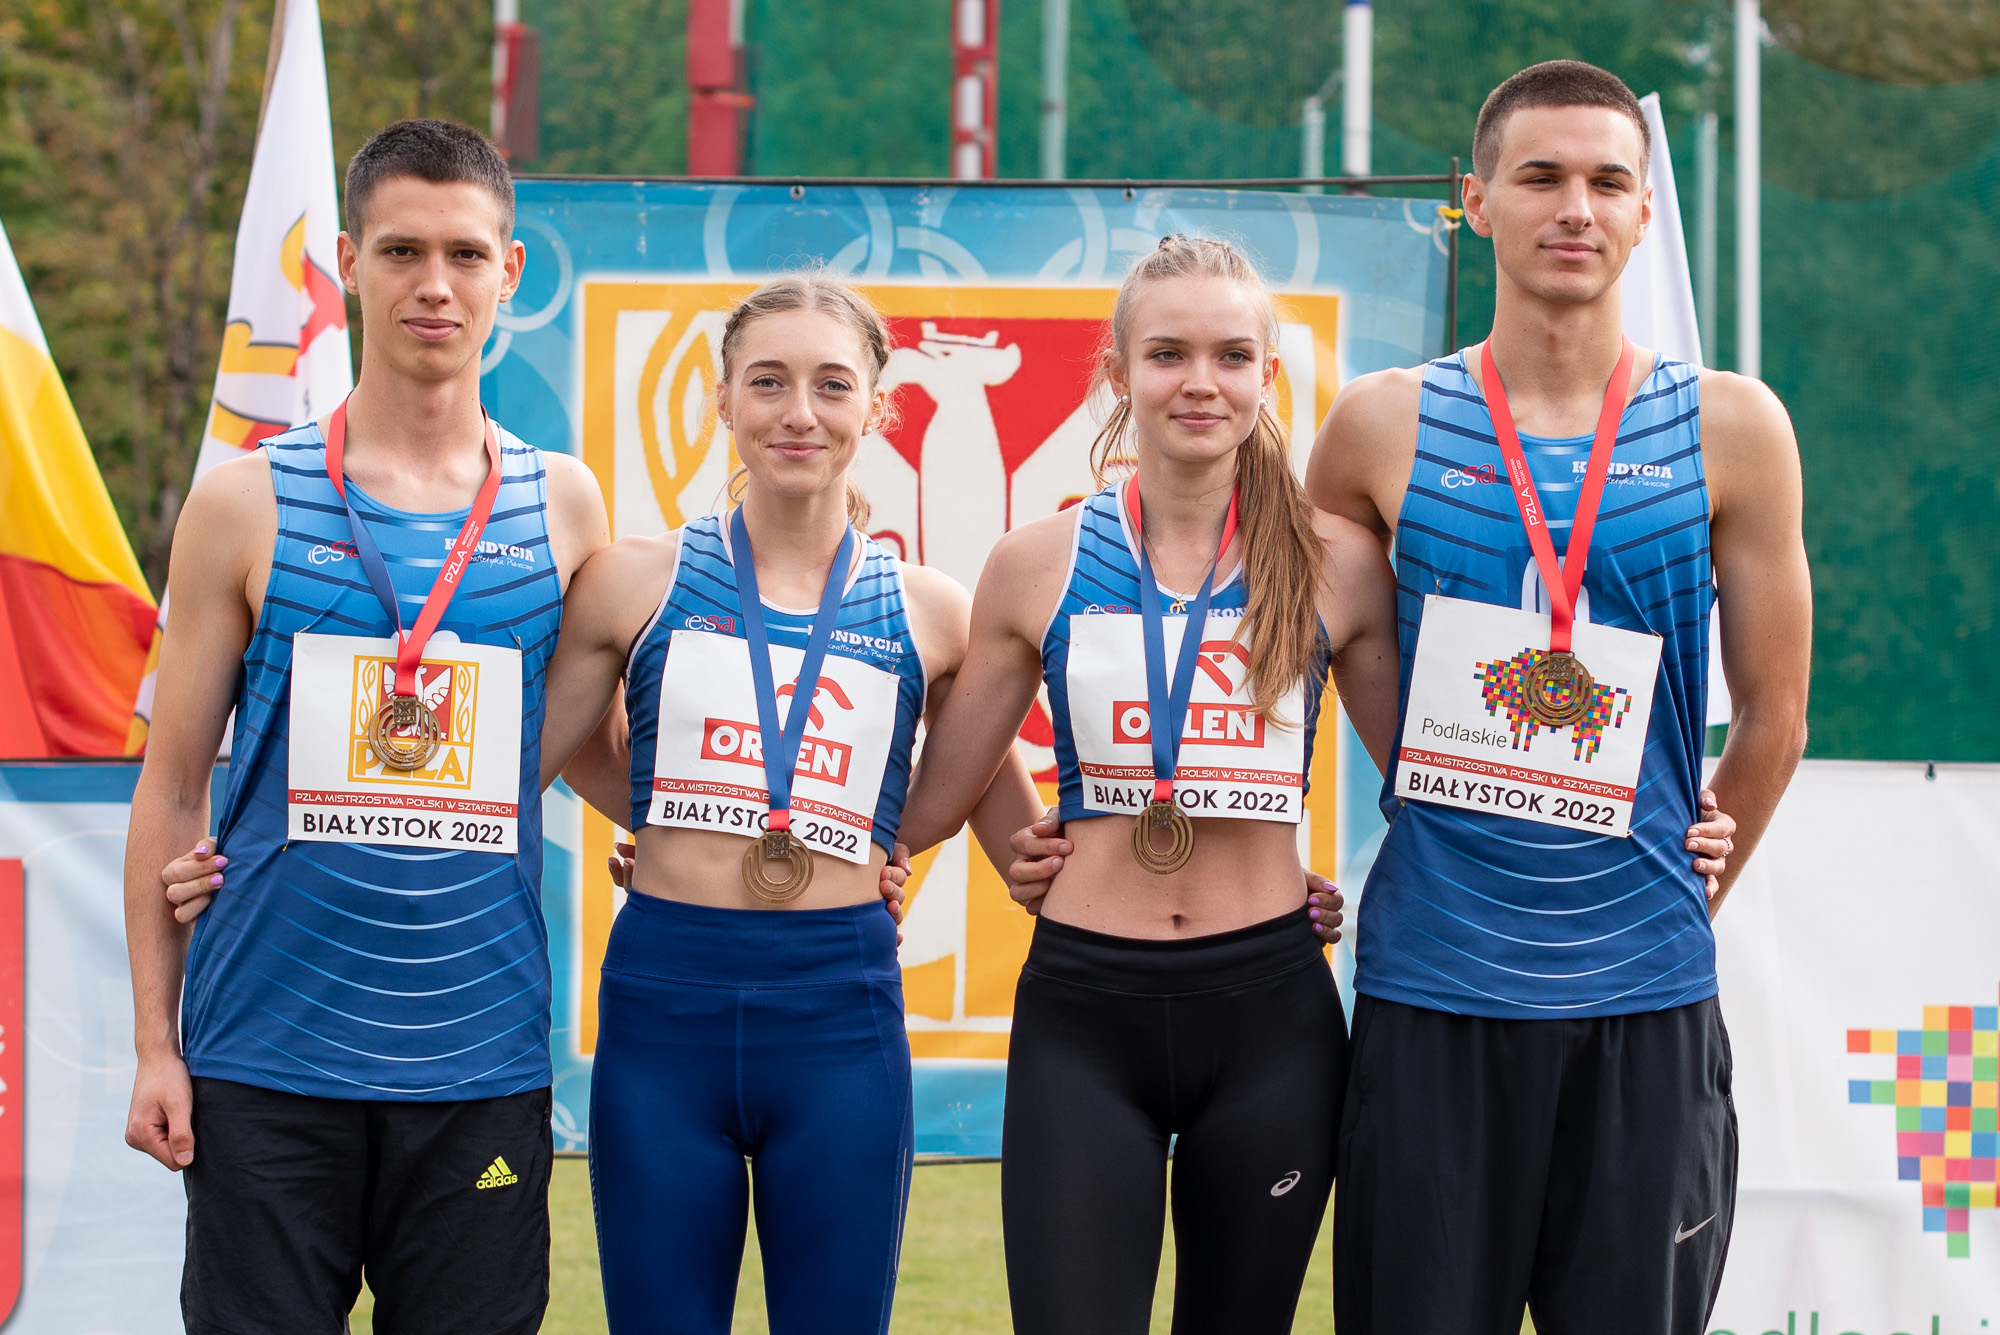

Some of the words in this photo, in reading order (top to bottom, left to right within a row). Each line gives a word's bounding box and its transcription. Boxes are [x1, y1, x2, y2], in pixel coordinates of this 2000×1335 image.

[1572, 461, 1673, 479] KNDYCJA
[1521, 487, 1540, 526] PZLA
[443, 550, 468, 584] PZLA
[444, 538, 535, 563] KNDYCJA
[807, 624, 904, 654] NDYCJA
[1120, 706, 1256, 742] OLEN
[1421, 718, 1508, 749] Podlaskie
[710, 725, 843, 778] OREN
[1084, 765, 1106, 776] PZLA
[1181, 769, 1219, 779] POLSKI
[1222, 770, 1233, 779] W
[1233, 771, 1298, 785] SZTAFETACH
[1405, 750, 1432, 763] PZLA
[1432, 755, 1509, 777] MISTRZOSTWA
[1509, 768, 1549, 784] POLSKI
[1550, 775, 1562, 786] W
[1562, 778, 1629, 799] SZTAFETACH
[295, 792, 322, 803] PZLA
[325, 794, 404, 807] MISTRZOSTWA
[406, 797, 444, 809] POLSKI
[446, 800, 456, 810] W
[457, 802, 513, 815] SZTAFETACH
[660, 780, 686, 791] PZLA
[686, 784, 760, 799] MISTRZOSTWA
[761, 793, 800, 808] PKI
[801, 800, 813, 810] W
[813, 804, 868, 829] SZTAFETACH
[1228, 789, 1289, 814] 2022
[1408, 771, 1546, 814] BIAŁYSTOK
[1551, 797, 1616, 827] 2022
[303, 812, 443, 841] BIAŁYSTOK
[450, 821, 504, 845] 2022
[662, 800, 797, 832] BIAŁYSTO
[803, 821, 859, 855] 2022
[476, 1174, 518, 1190] adidas
